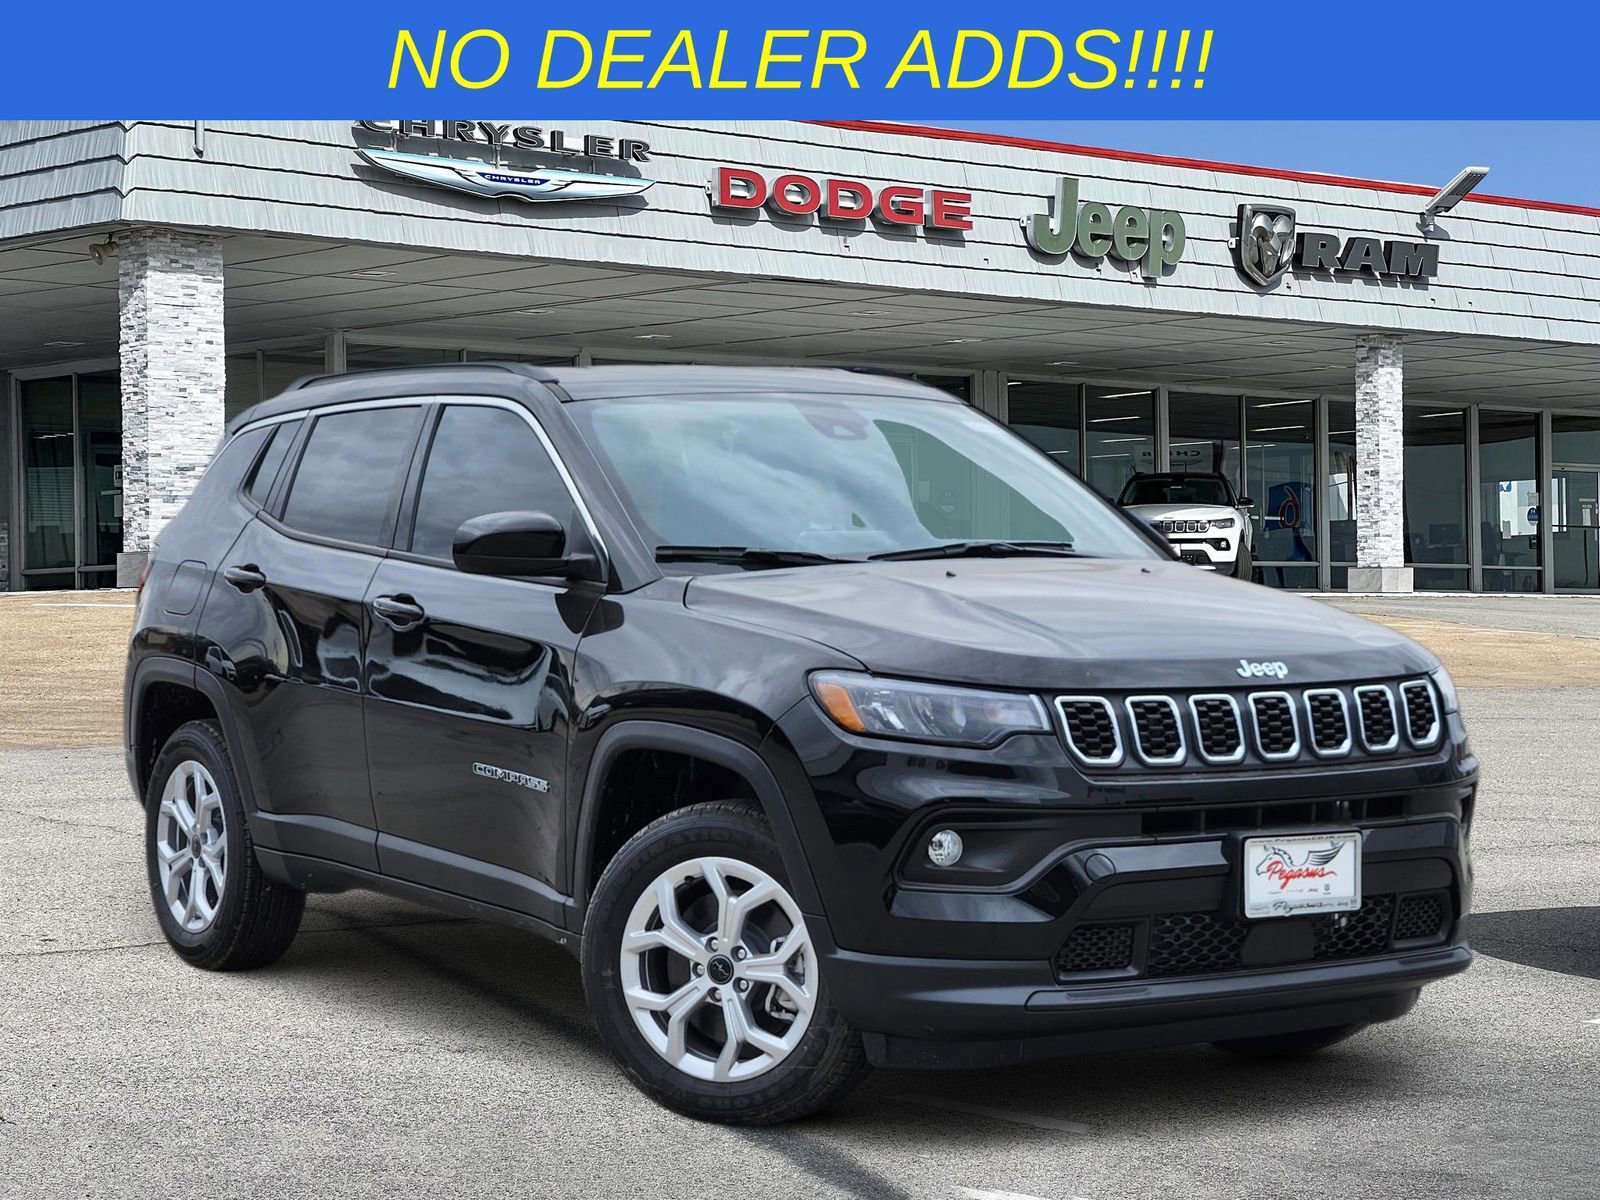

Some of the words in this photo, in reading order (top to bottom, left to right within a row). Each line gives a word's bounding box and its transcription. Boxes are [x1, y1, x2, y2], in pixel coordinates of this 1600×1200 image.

[484, 174, 541, 185] CHRYSLER
[713, 167, 973, 231] DODGE
[1027, 177, 1186, 278] Jeep
[1297, 232, 1440, 277] RAM
[1236, 659, 1288, 679] Jeep
[473, 762, 550, 793] COMPASS
[1266, 860, 1337, 890] Pegasus
